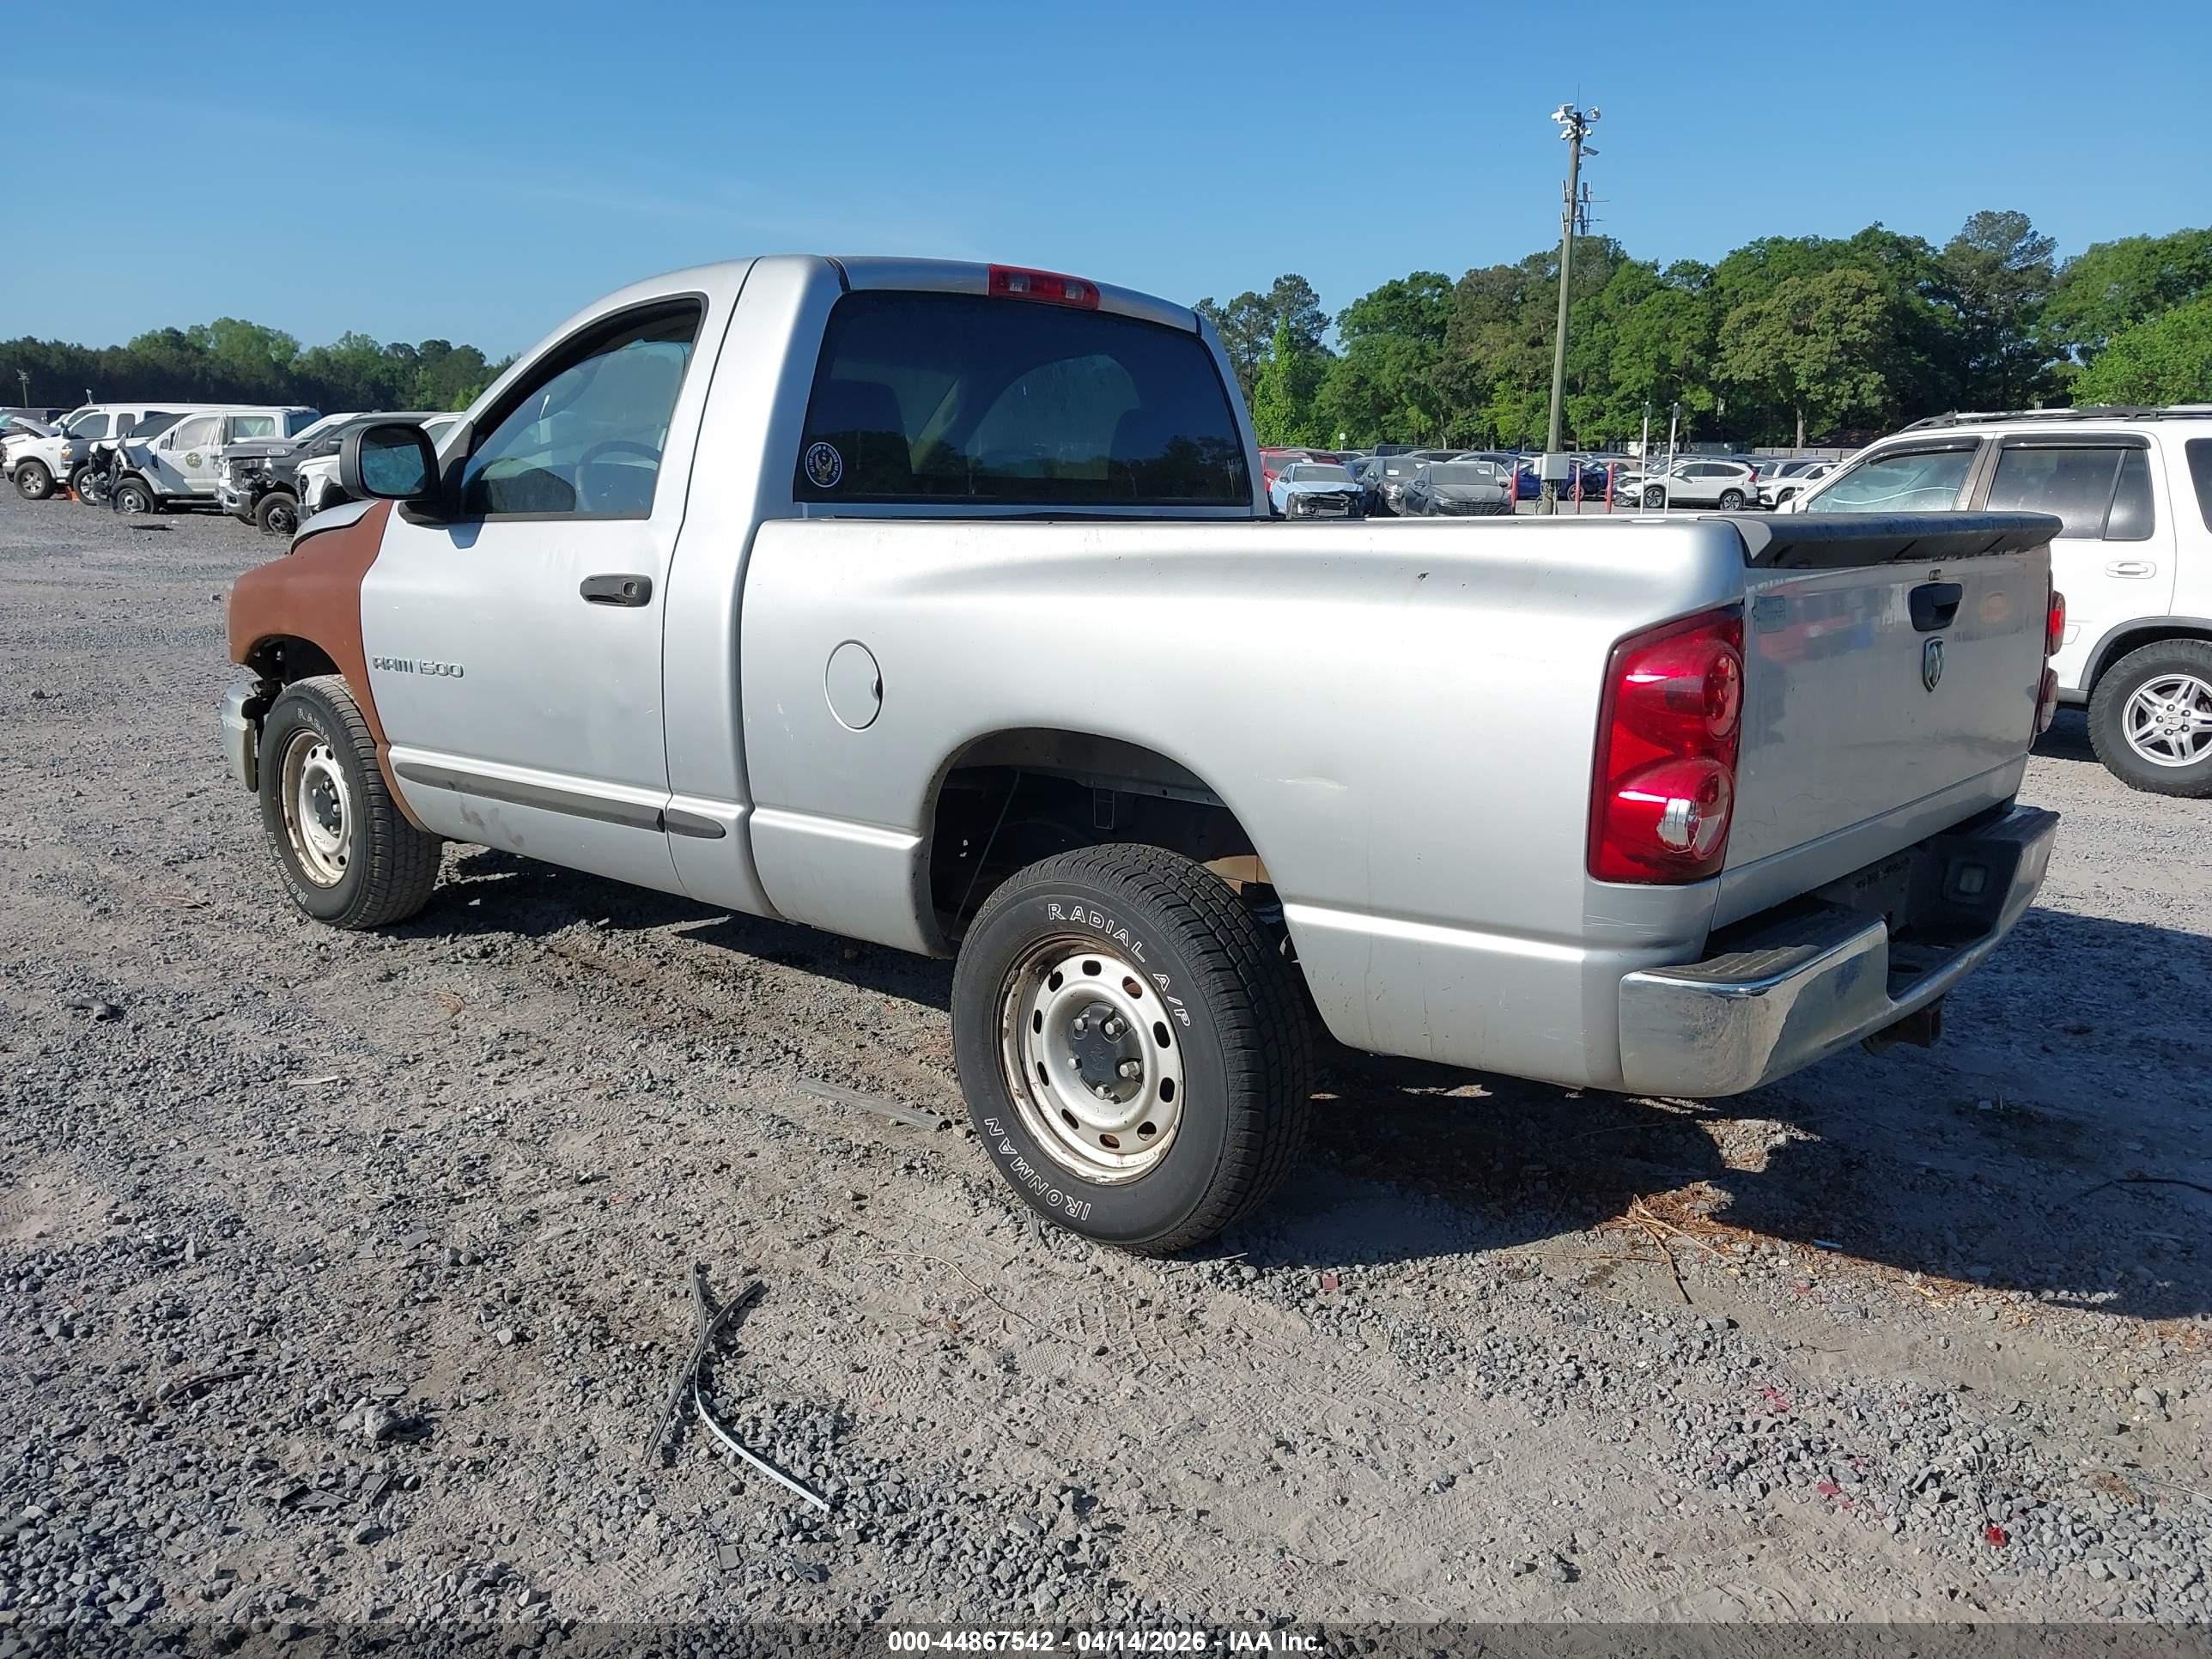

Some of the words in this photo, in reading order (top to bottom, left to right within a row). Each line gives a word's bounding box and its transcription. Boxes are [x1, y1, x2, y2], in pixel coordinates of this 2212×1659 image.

[372, 656, 414, 674] RAM
[416, 659, 465, 678] 1500
[267, 832, 308, 905] IRONMAN
[1048, 903, 1146, 963] RADIAL
[1152, 973, 1191, 1027] A/P
[984, 1117, 1091, 1221] IRONMAN
